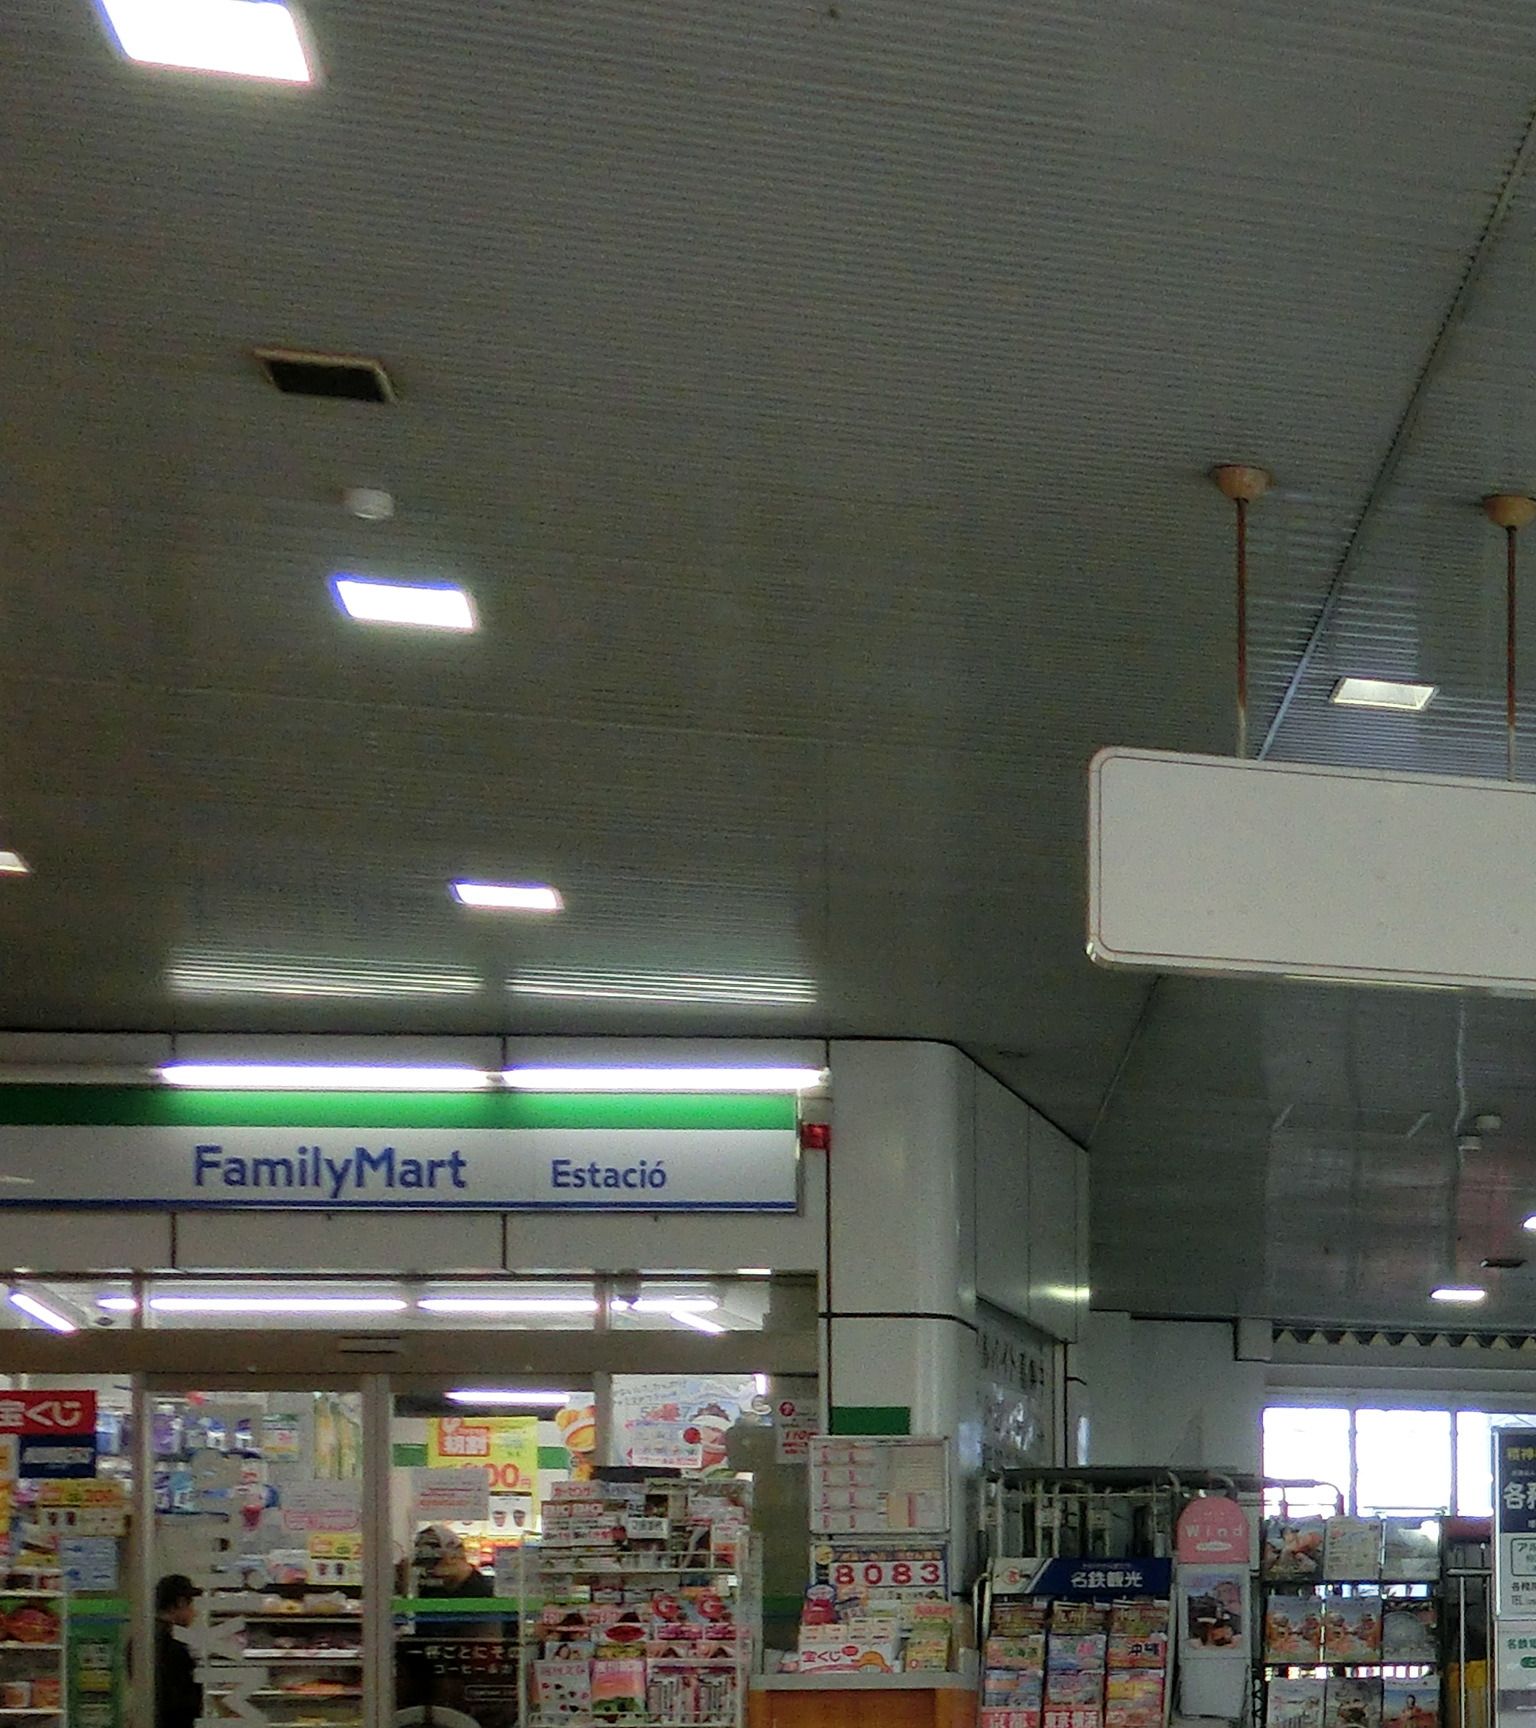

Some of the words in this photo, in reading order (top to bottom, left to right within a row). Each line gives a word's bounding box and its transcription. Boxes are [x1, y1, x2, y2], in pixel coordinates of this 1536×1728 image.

[193, 1144, 468, 1199] FamilyMart
[551, 1158, 667, 1190] Estació
[1185, 1523, 1243, 1538] Wind
[1070, 1572, 1144, 1589] 名鉄観光
